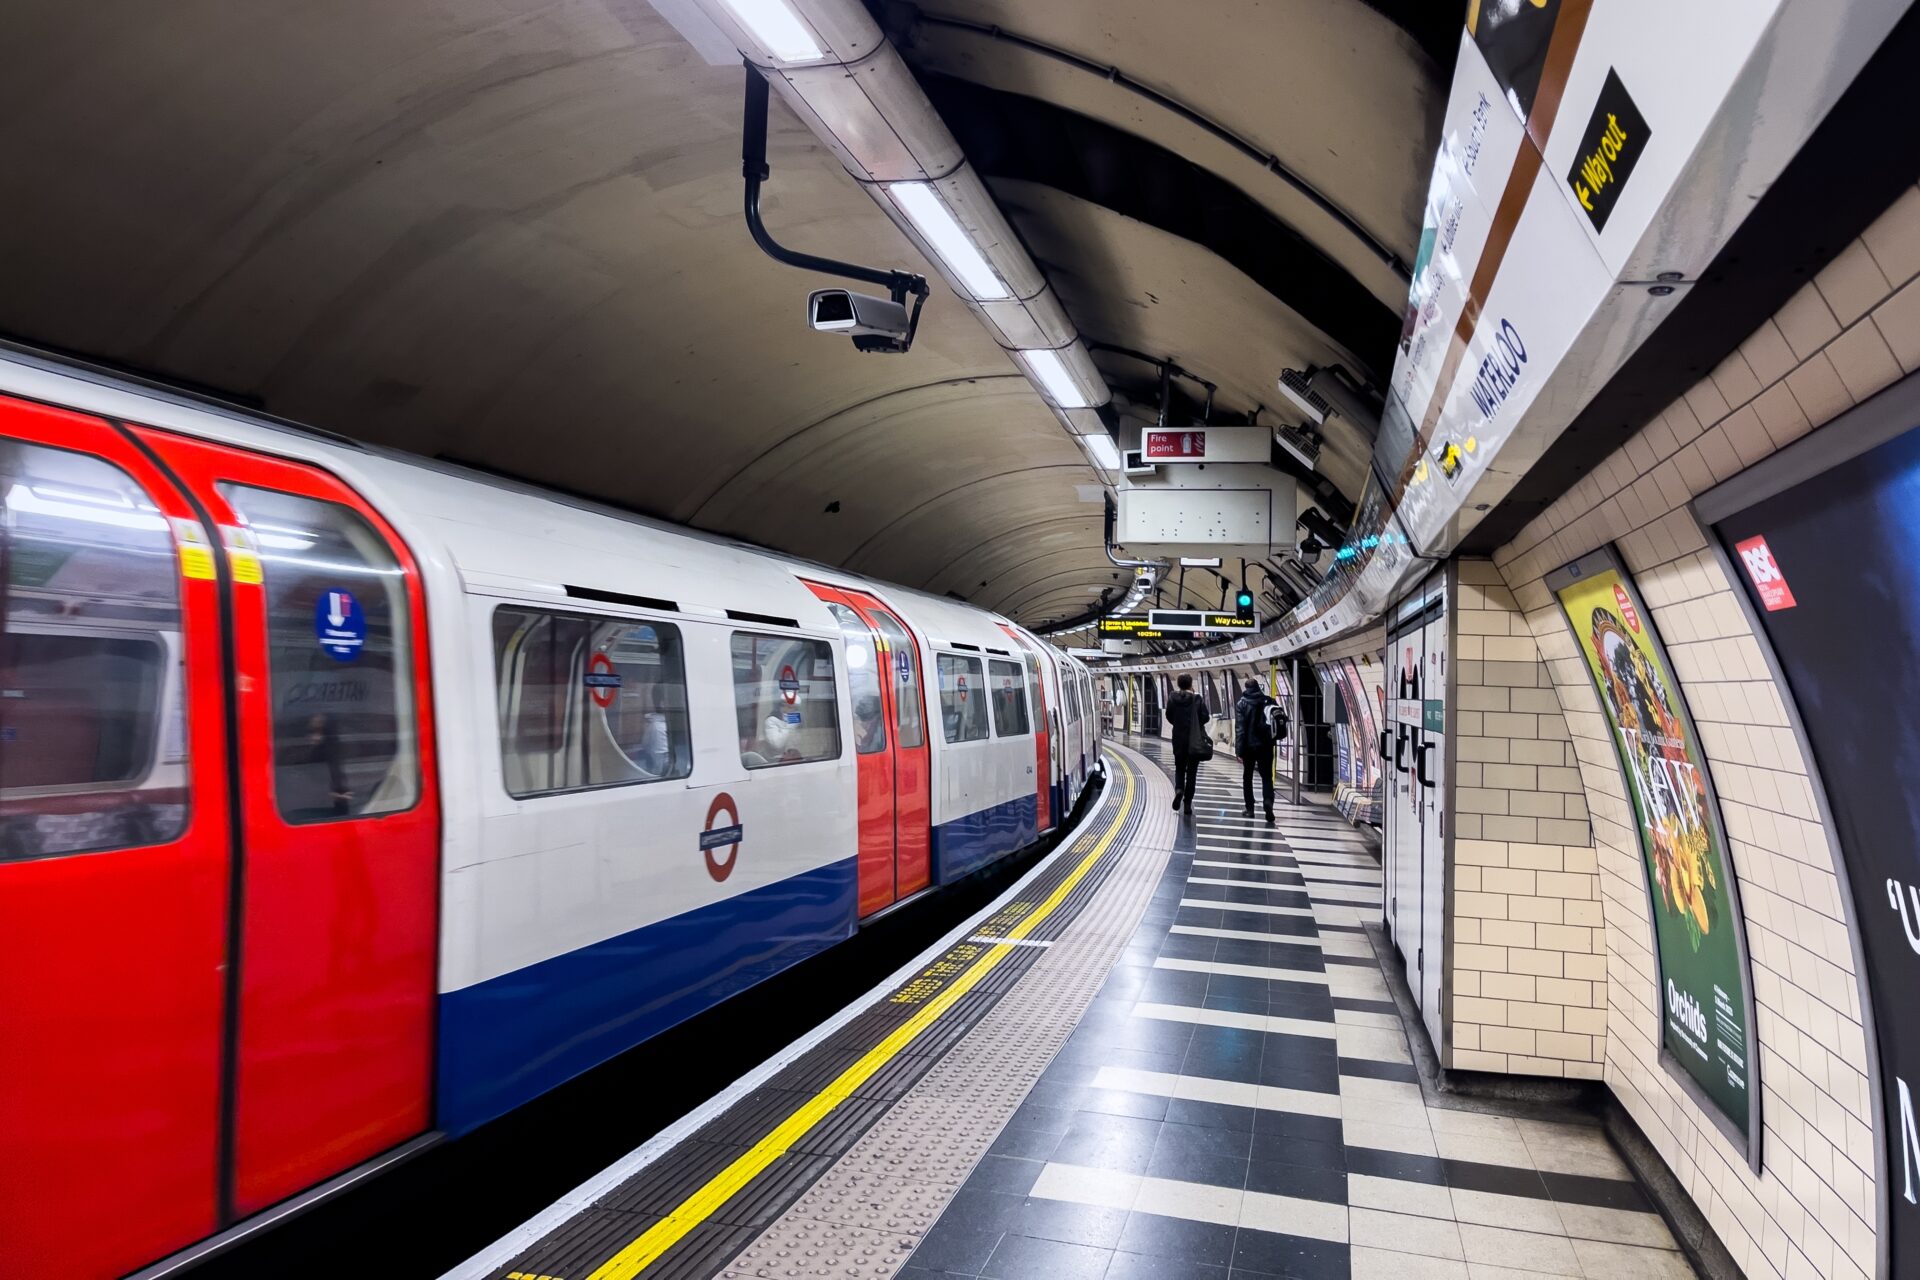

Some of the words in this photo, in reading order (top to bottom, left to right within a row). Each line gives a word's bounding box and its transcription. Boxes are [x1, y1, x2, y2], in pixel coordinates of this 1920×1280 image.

[1473, 91, 1491, 130] Bank
[1581, 147, 1614, 195] Way
[1602, 113, 1627, 162] out
[1470, 318, 1527, 423] WATERLOO
[1151, 434, 1167, 442] Fire
[1151, 444, 1174, 454] point
[1741, 544, 1781, 585] RSC
[1215, 616, 1231, 626] Way
[1668, 977, 1707, 1043] Orchids
